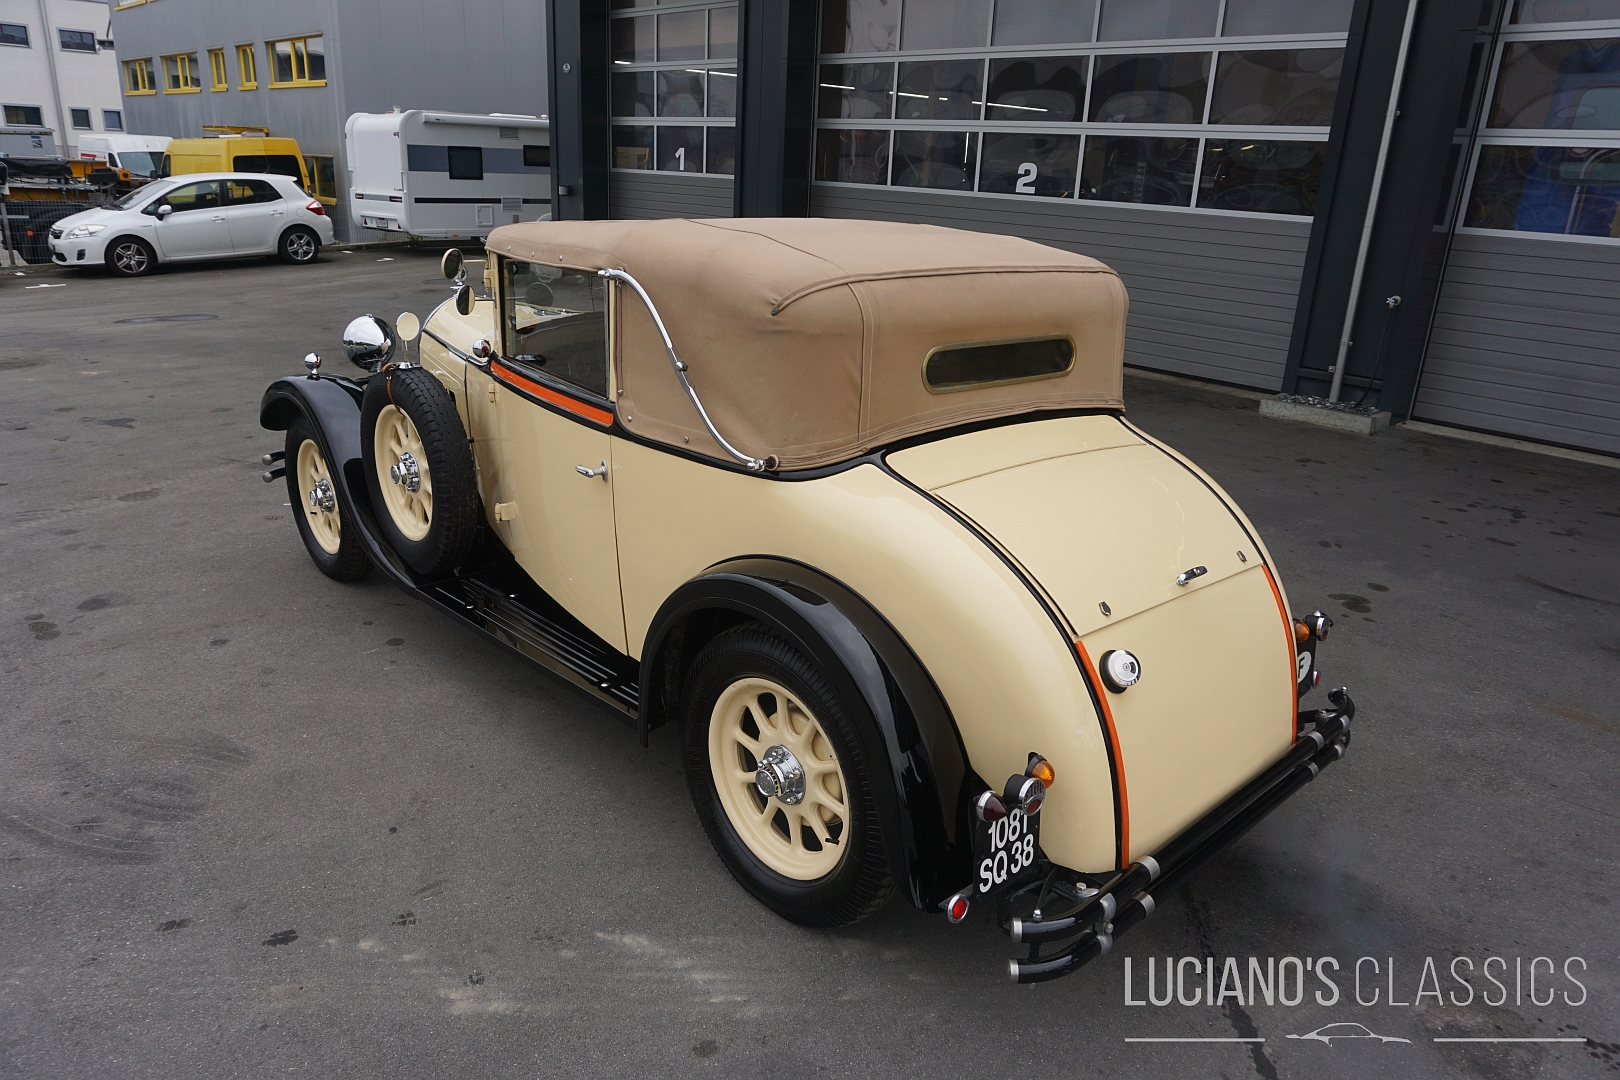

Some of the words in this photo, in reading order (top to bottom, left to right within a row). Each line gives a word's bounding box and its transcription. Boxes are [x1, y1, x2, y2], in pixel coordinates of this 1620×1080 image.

[675, 147, 685, 171] 1
[1015, 162, 1038, 194] 2
[979, 850, 1008, 892] SQ
[1010, 834, 1034, 873] 38
